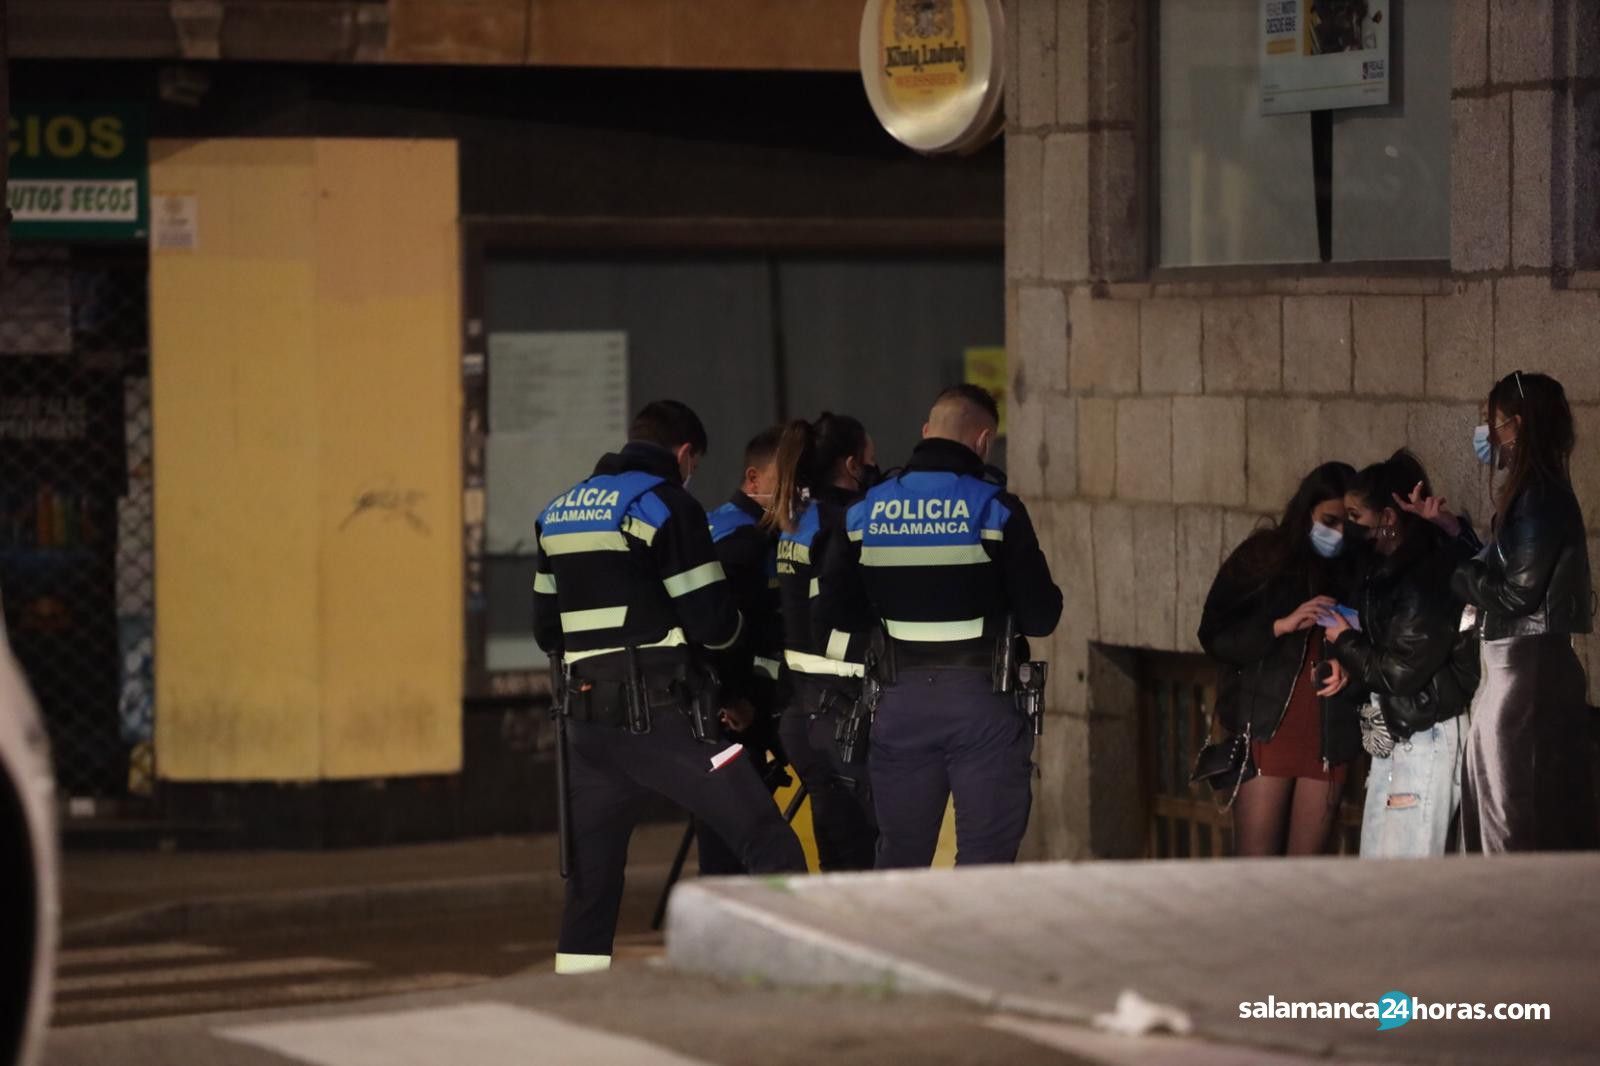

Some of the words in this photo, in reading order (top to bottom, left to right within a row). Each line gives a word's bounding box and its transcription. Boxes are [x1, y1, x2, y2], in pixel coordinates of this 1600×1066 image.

[71, 185, 134, 212] SECOS
[545, 509, 612, 524] SALAMANCA
[870, 499, 970, 520] POLICIA
[868, 522, 969, 535] SALAMANCA
